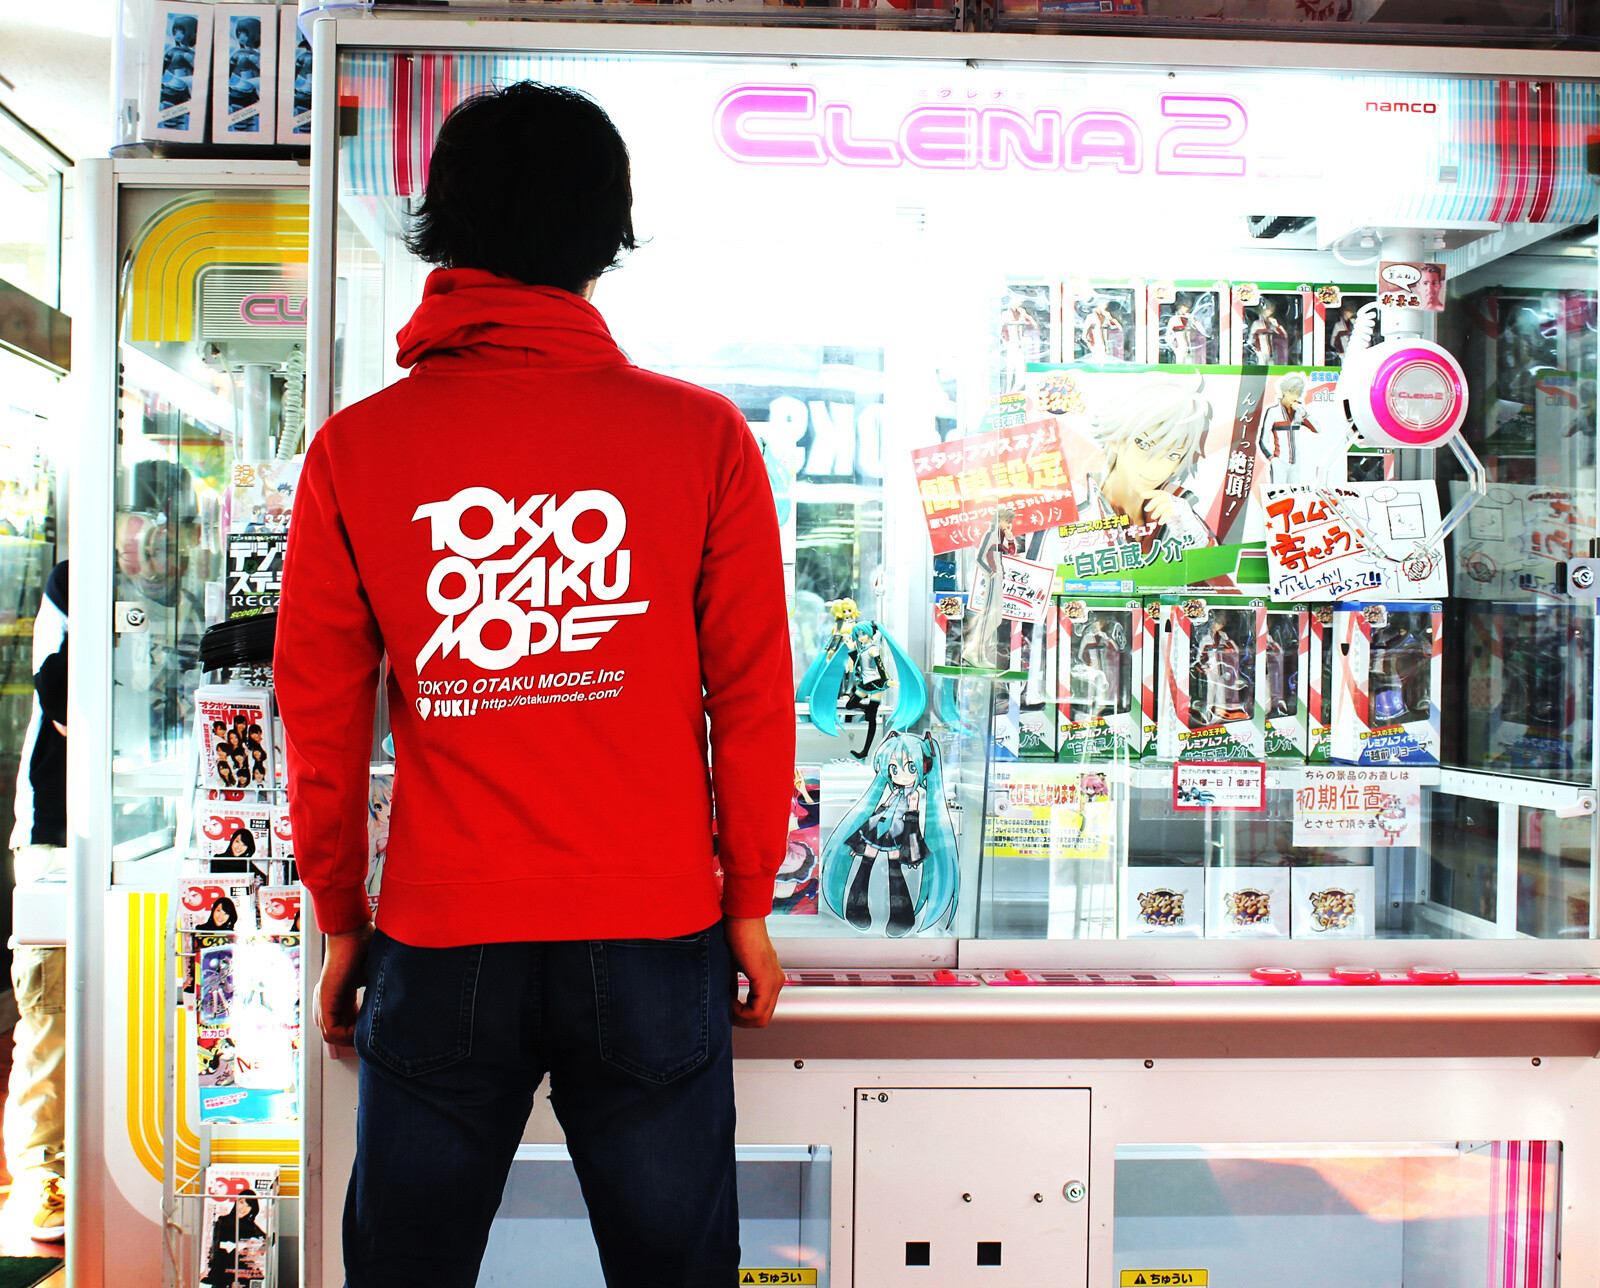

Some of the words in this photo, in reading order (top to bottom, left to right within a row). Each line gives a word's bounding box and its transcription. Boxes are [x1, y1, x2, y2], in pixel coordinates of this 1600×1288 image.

[1366, 101, 1436, 113] namco
[713, 82, 1143, 174] CLENA
[1155, 93, 1248, 175] 2
[241, 294, 307, 325] CL
[1310, 371, 1339, 382] SEGA
[919, 450, 1069, 516] 簡単設定
[411, 487, 627, 560] TOKYO
[1058, 514, 1130, 538] 新テニスの王子様
[426, 549, 631, 616] OTAKU
[415, 600, 650, 676] MODE
[418, 680, 468, 695] TOKYO
[472, 676, 534, 694] OTAKU
[537, 669, 625, 689] MODE.Inc
[433, 698, 478, 717] SUKI!
[481, 686, 624, 710] http://otakumode.com/
[221, 709, 263, 726] MAP
[1296, 785, 1381, 811] 初期位置
[758, 1272, 802, 1284] ちゅうい
[1149, 1273, 1193, 1284] ちゅうい
